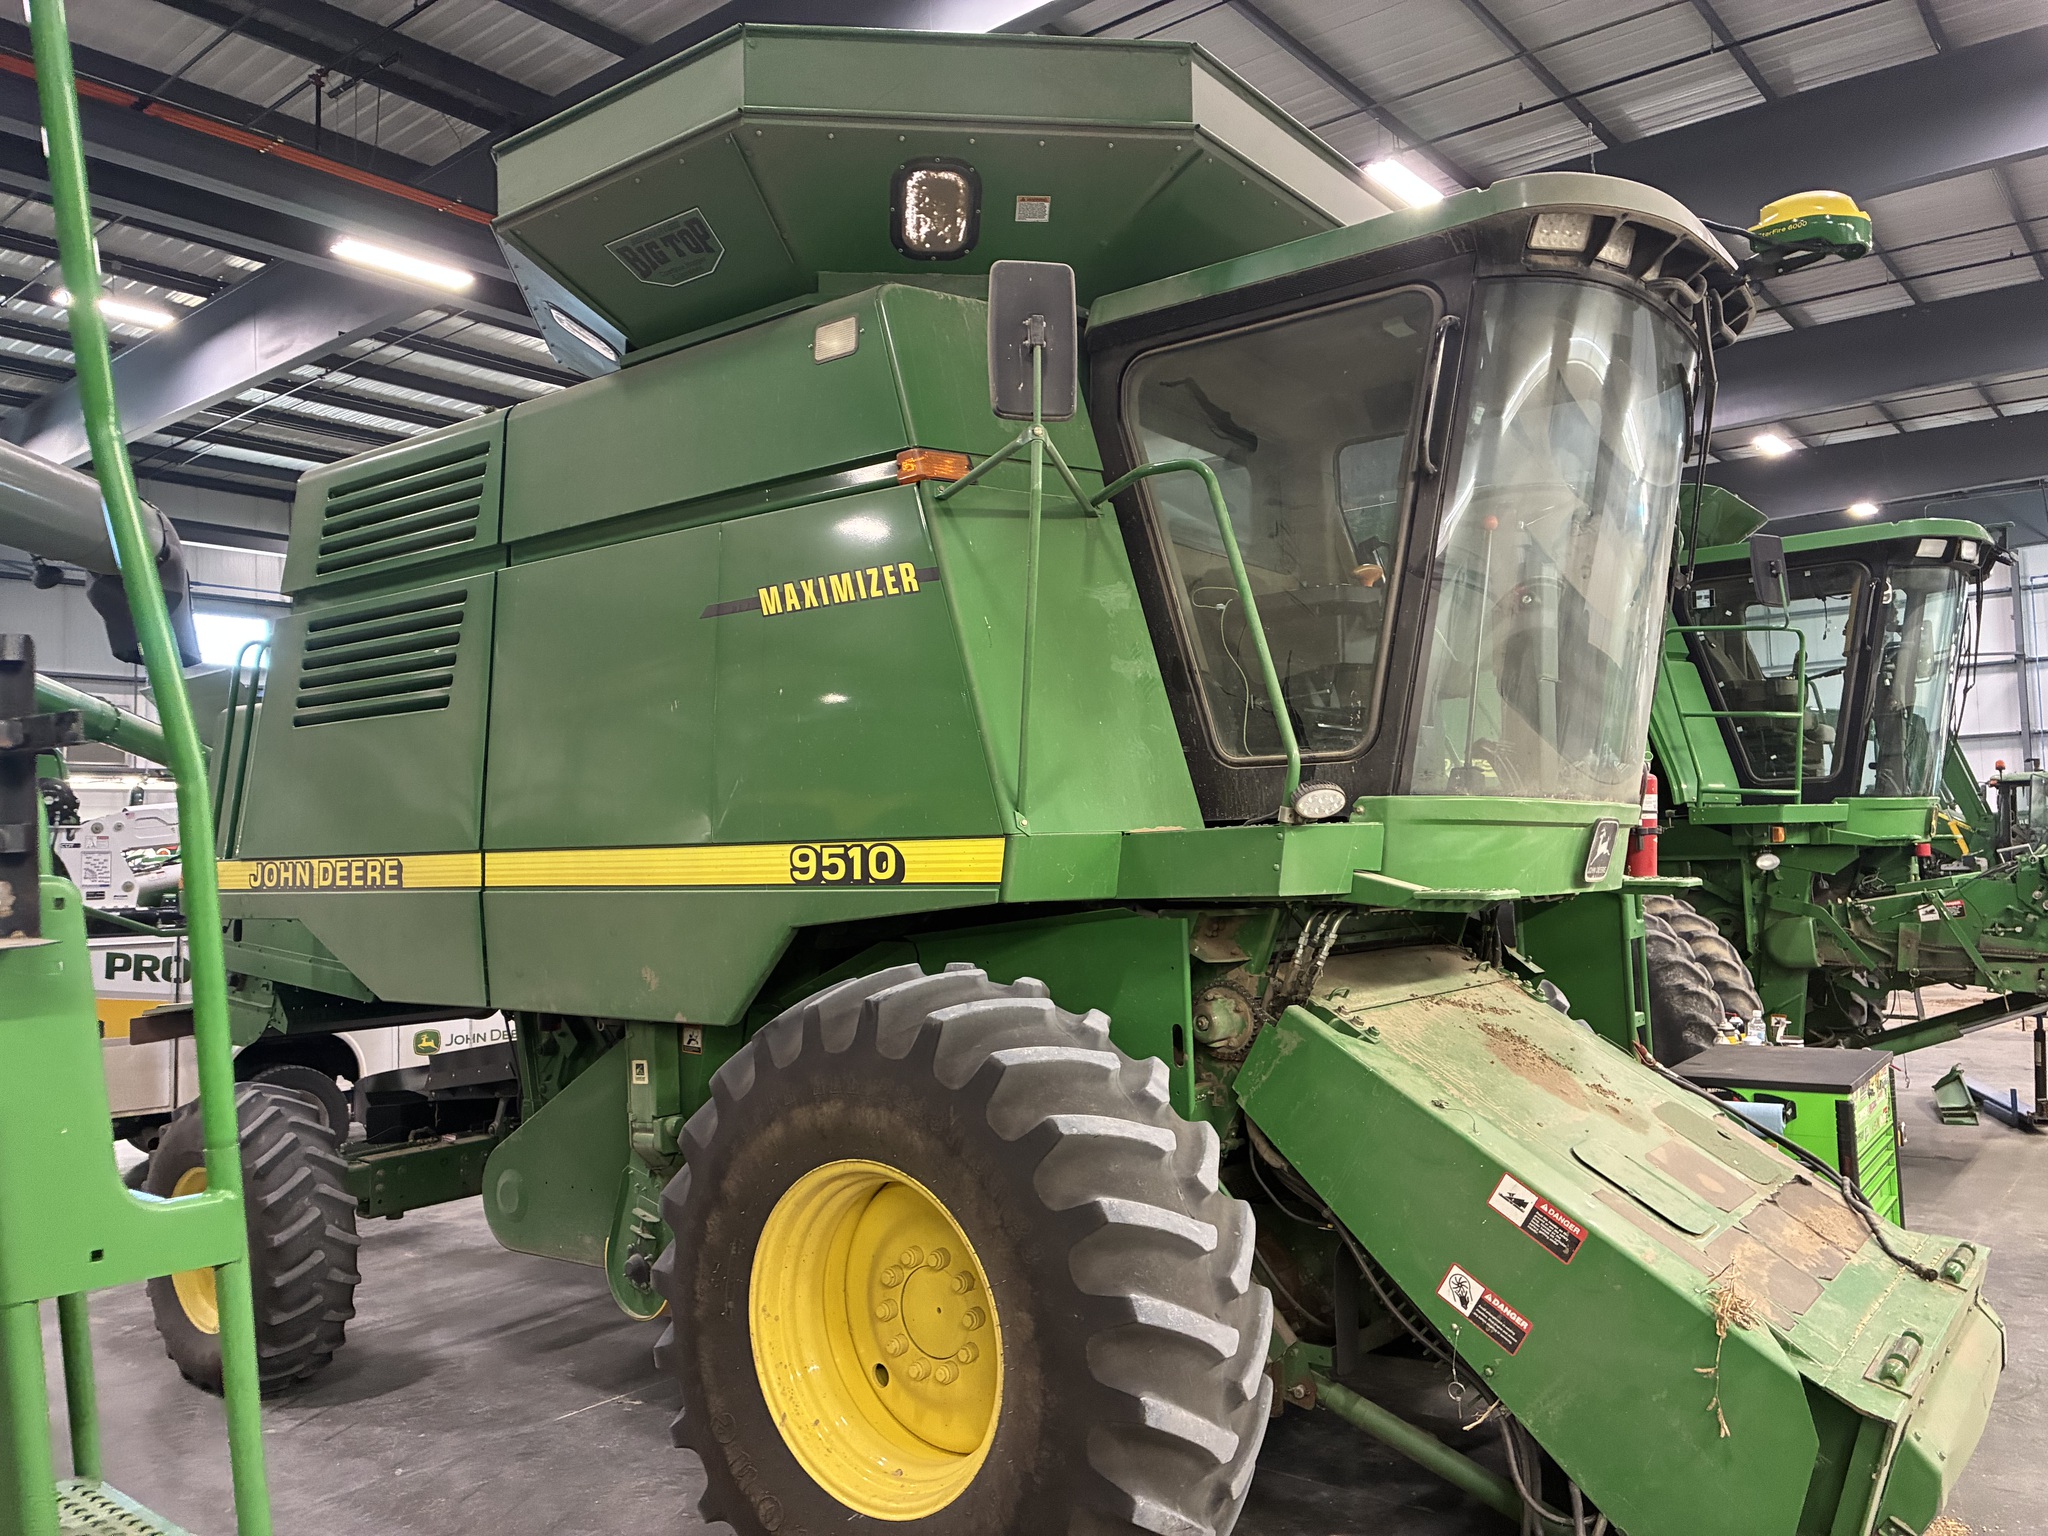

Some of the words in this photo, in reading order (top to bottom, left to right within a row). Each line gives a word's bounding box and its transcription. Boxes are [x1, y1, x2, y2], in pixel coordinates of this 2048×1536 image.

[616, 240, 672, 279] BIG
[660, 217, 716, 258] TOP
[758, 562, 920, 616] MAXIMIZER
[249, 861, 314, 890] JOHN
[317, 858, 404, 890] DEERE
[790, 843, 905, 885] 9510
[104, 952, 193, 984] PRO
[445, 1032, 487, 1047] JOHN
[1547, 1208, 1581, 1235] DANGER
[1491, 1299, 1529, 1330] DANGER
